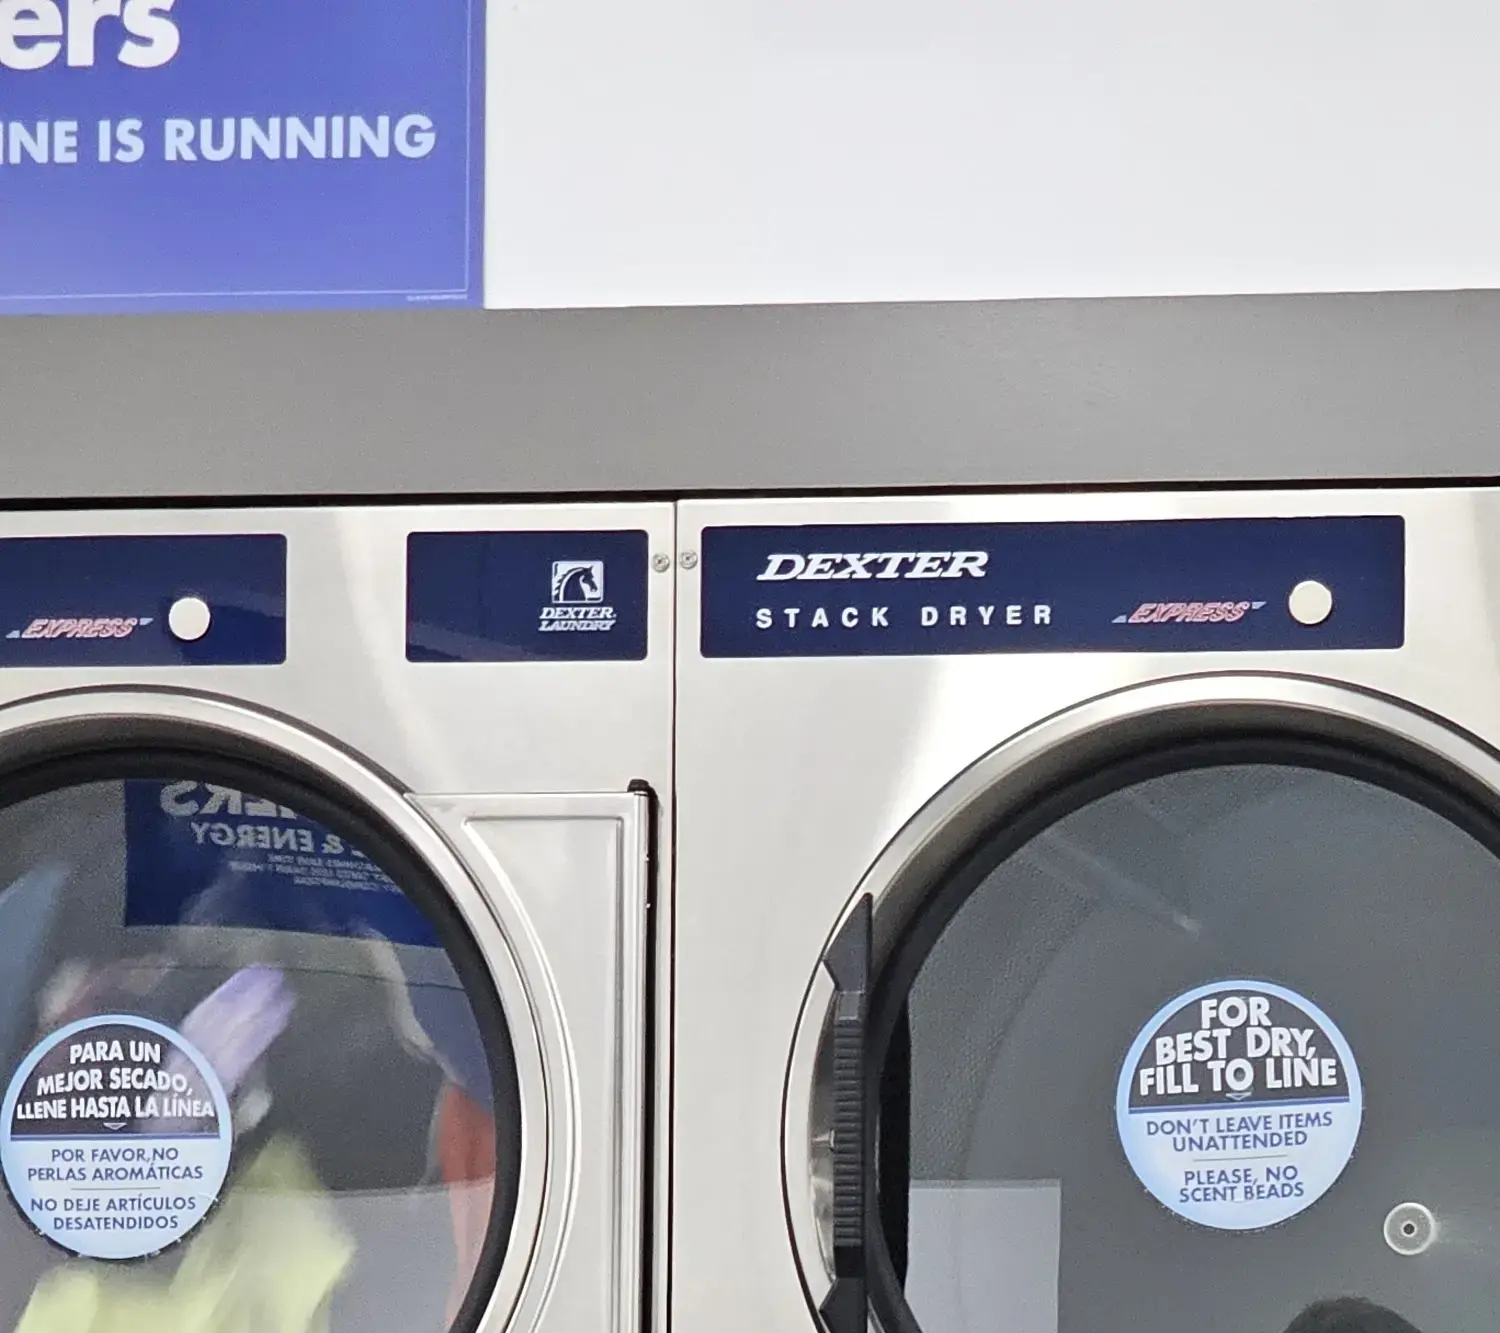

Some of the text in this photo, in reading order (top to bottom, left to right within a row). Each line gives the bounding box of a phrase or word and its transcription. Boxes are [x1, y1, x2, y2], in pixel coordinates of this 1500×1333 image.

[98, 118, 145, 163] IS
[165, 113, 436, 161] RUNNING
[756, 551, 988, 582] DEXTER
[539, 606, 614, 620] DEXTER
[755, 605, 1052, 630] STACK DRYER
[1128, 602, 1251, 625] EXPRESS
[21, 618, 138, 639] EXPRESS
[538, 619, 616, 632] LAUNDRY
[1201, 996, 1272, 1029] FOR
[69, 1040, 161, 1065] PARA UN
[1155, 1027, 1317, 1066] BEST DRY,
[36, 1067, 194, 1096] MEJOR SECADO,
[1139, 1057, 1338, 1096] FILL TO LINE
[17, 1093, 215, 1120] LLENE HASTA LA LÍNEA
[1216, 1115, 1272, 1133] LEAVE
[1279, 1111, 1333, 1130] ITEMS
[1172, 1130, 1308, 1152] UNATTENDED
[52, 1149, 85, 1162] POR
[152, 1148, 179, 1161] NO
[27, 1163, 204, 1182] PERLAS AROMÁTICAS
[1183, 1165, 1298, 1187] PLEASE, NO
[30, 1193, 196, 1212] NO DEJE ARTÍCULOS
[1179, 1182, 1304, 1203] SCENT BEADS
[53, 1215, 178, 1231] DESATENDIDOS
